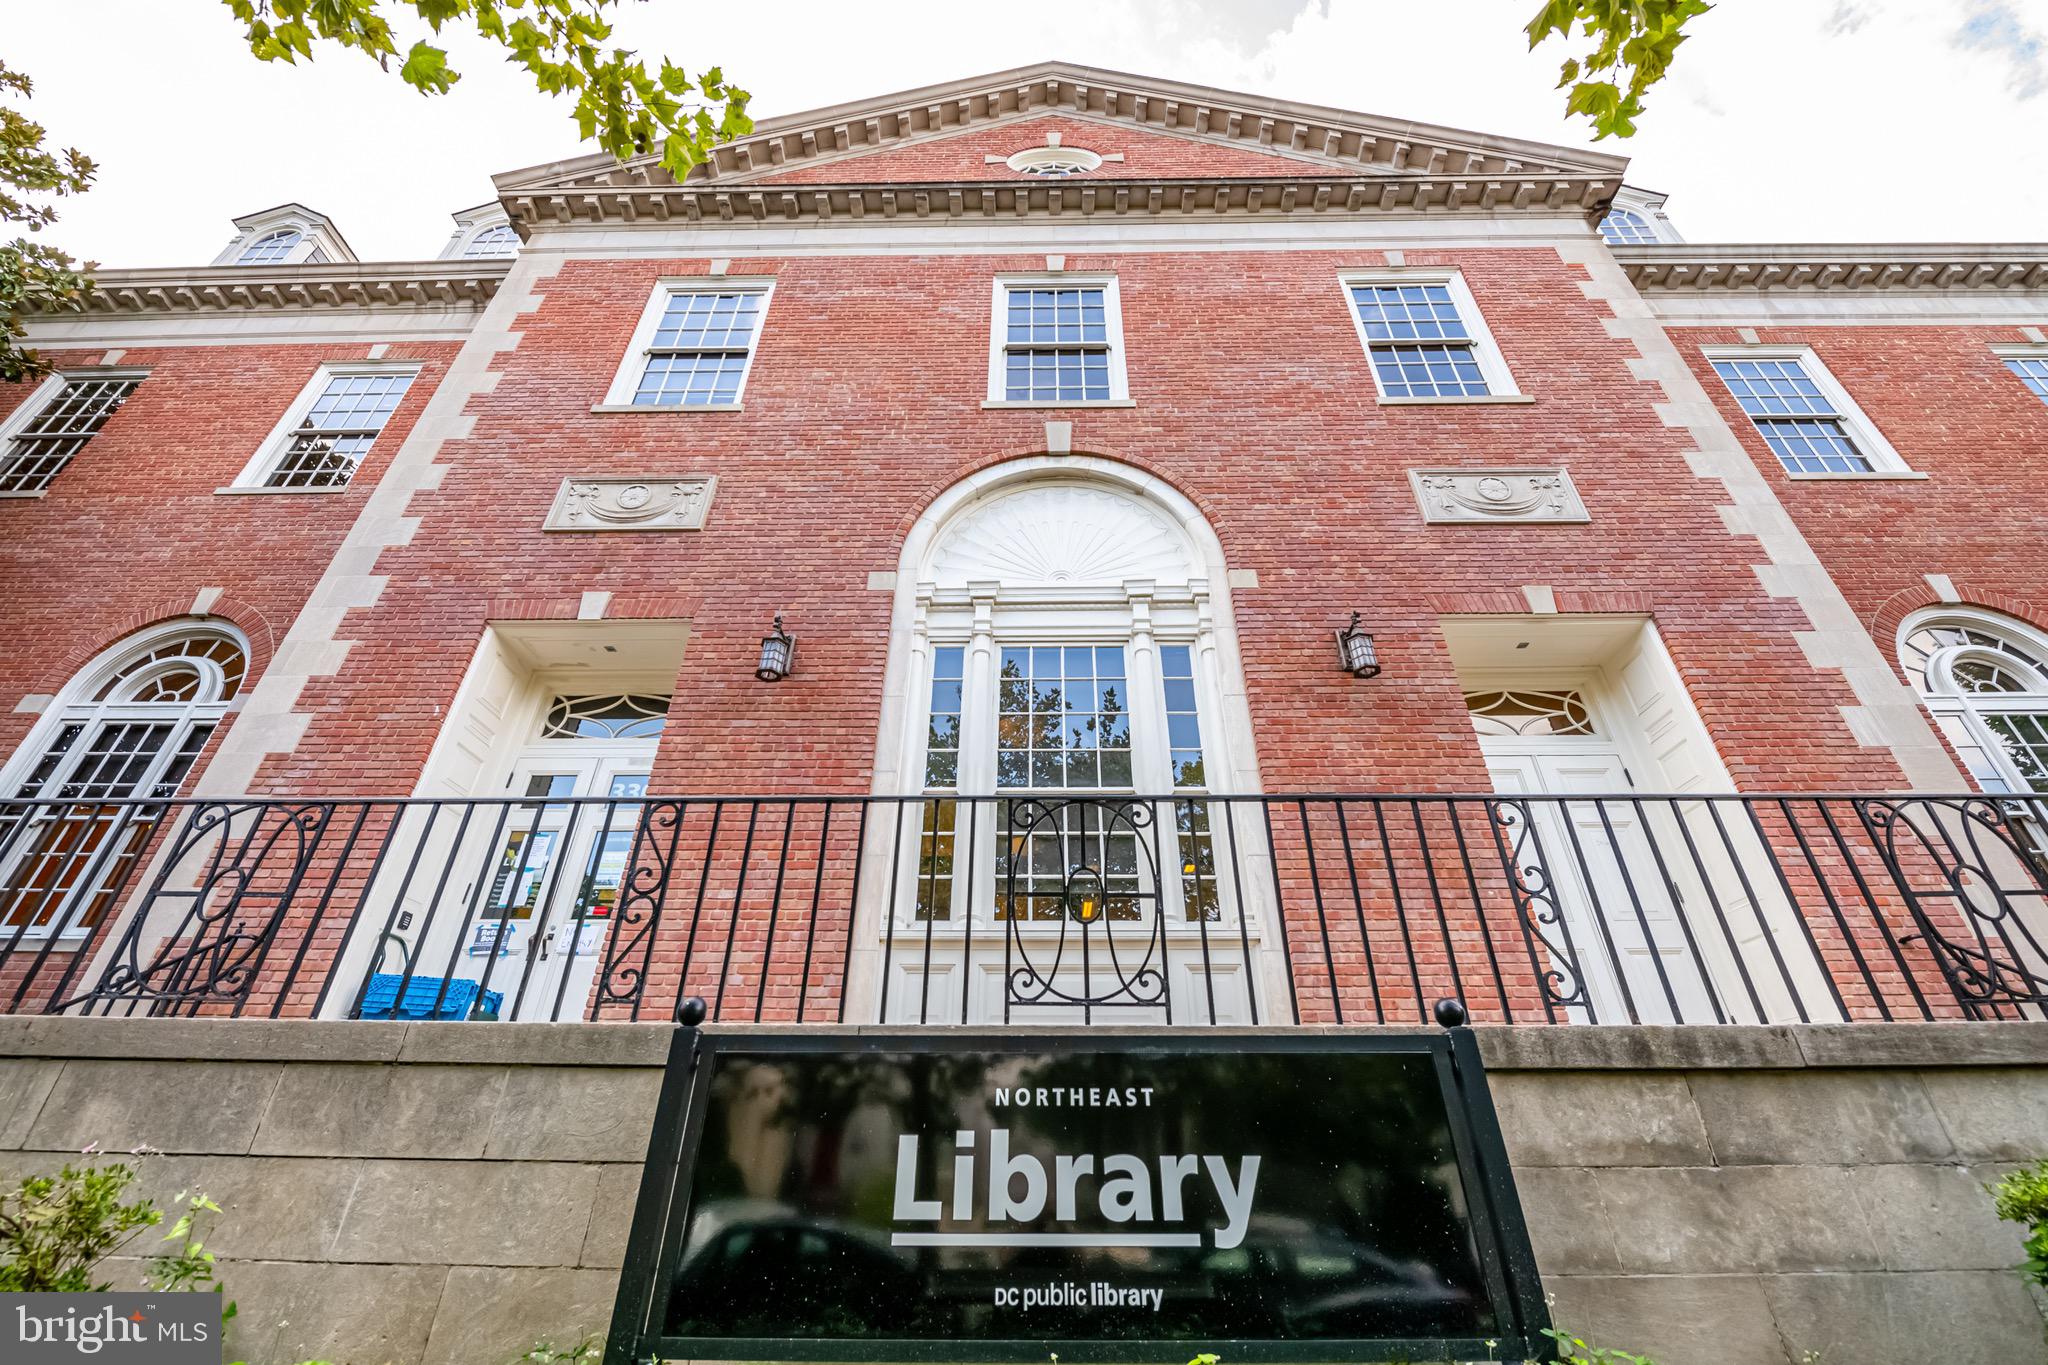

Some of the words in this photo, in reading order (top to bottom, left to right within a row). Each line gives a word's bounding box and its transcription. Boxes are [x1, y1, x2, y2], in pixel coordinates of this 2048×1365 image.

[612, 783, 647, 798] 33
[995, 1087, 1154, 1107] NORTHEAST
[893, 1129, 1262, 1249] Library
[994, 1287, 1019, 1306] DC
[1023, 1282, 1087, 1311] public
[1091, 1282, 1163, 1312] library
